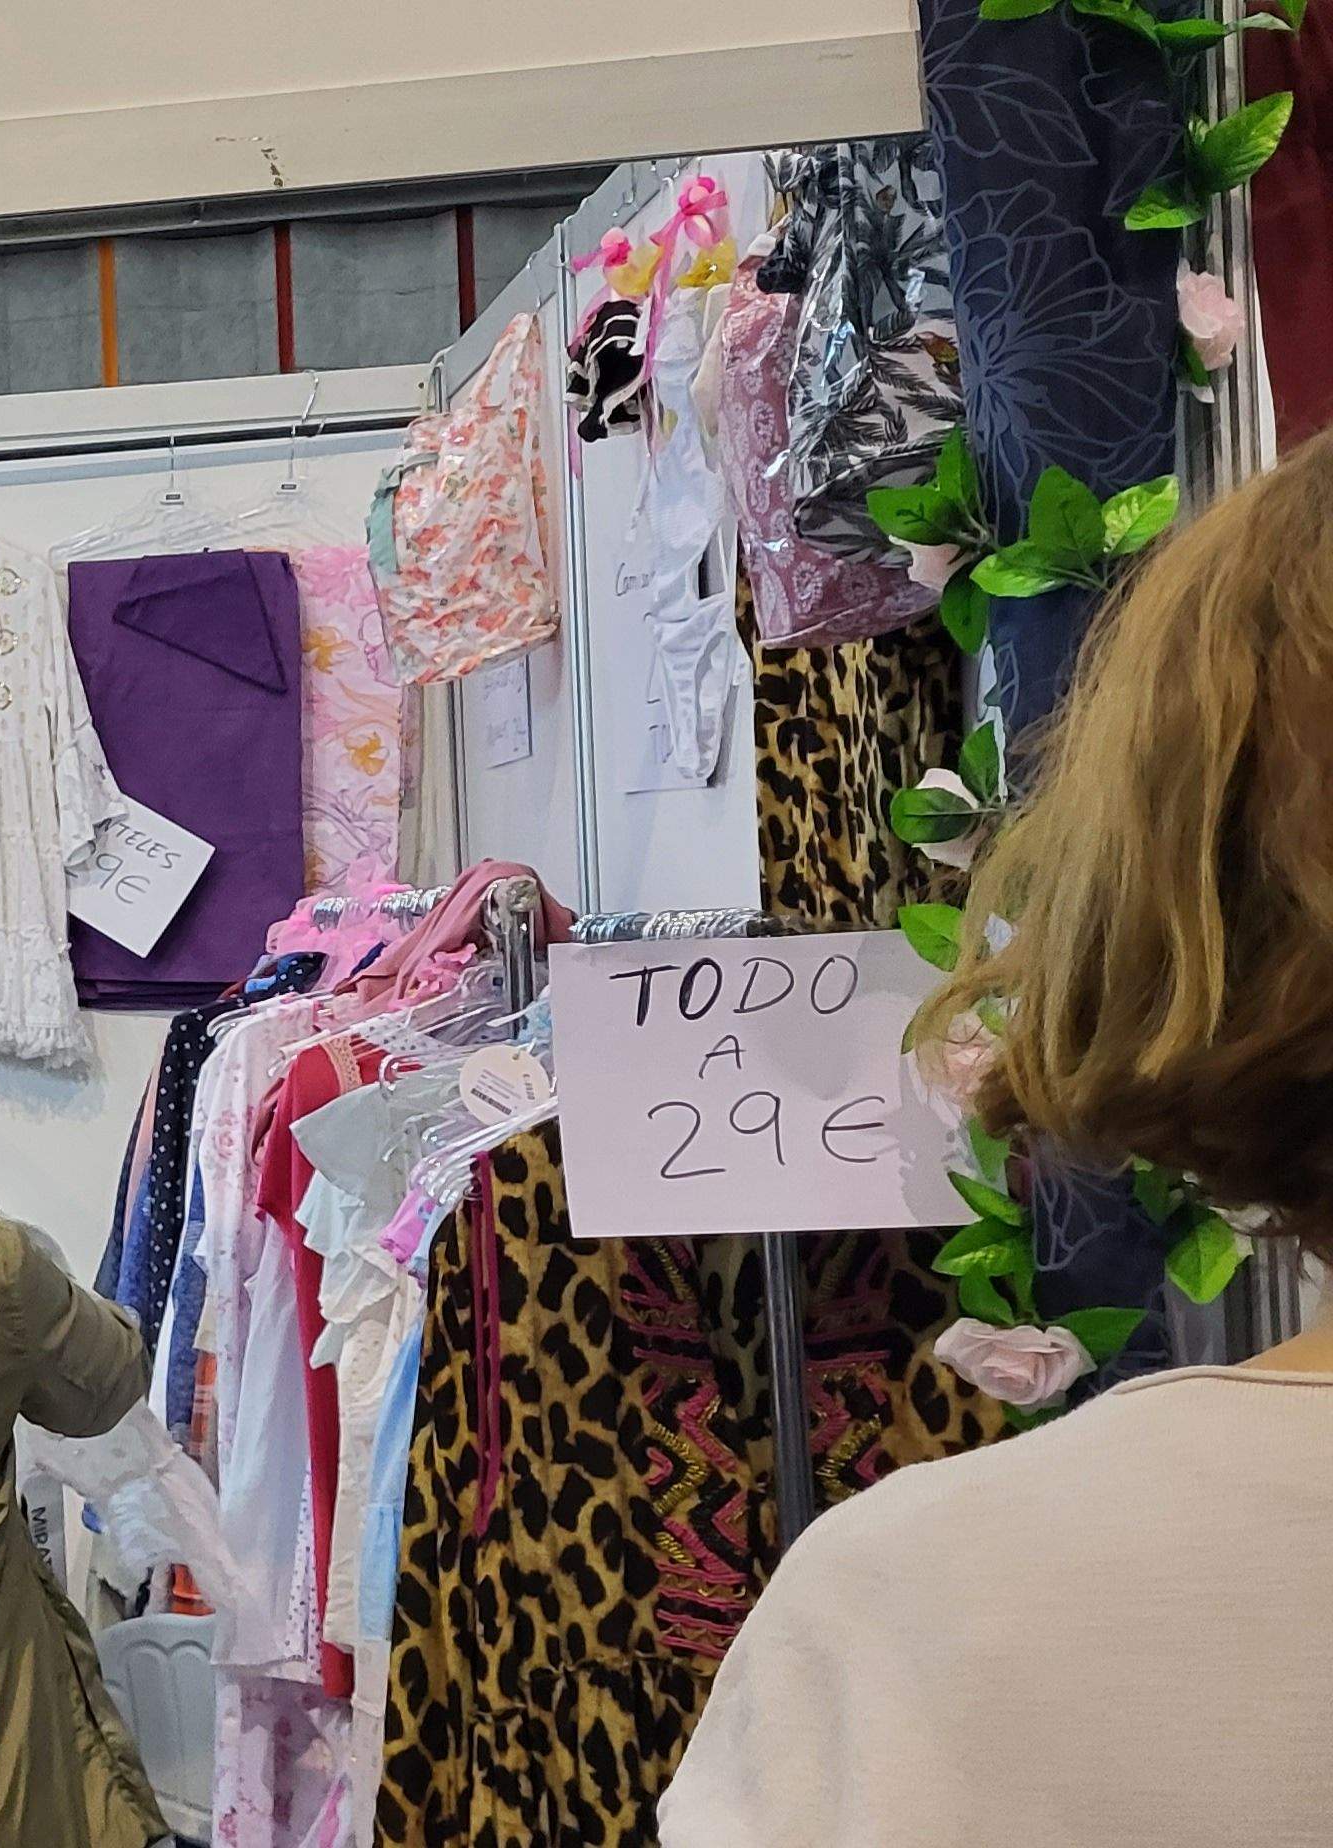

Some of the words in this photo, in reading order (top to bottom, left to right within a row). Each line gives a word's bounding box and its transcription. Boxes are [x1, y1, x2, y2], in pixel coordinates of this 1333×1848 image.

[97, 817, 182, 870] NTELES
[64, 852, 152, 905] 9€
[608, 953, 859, 1027] TODO
[698, 1034, 747, 1079] A
[647, 1090, 886, 1180] 29€
